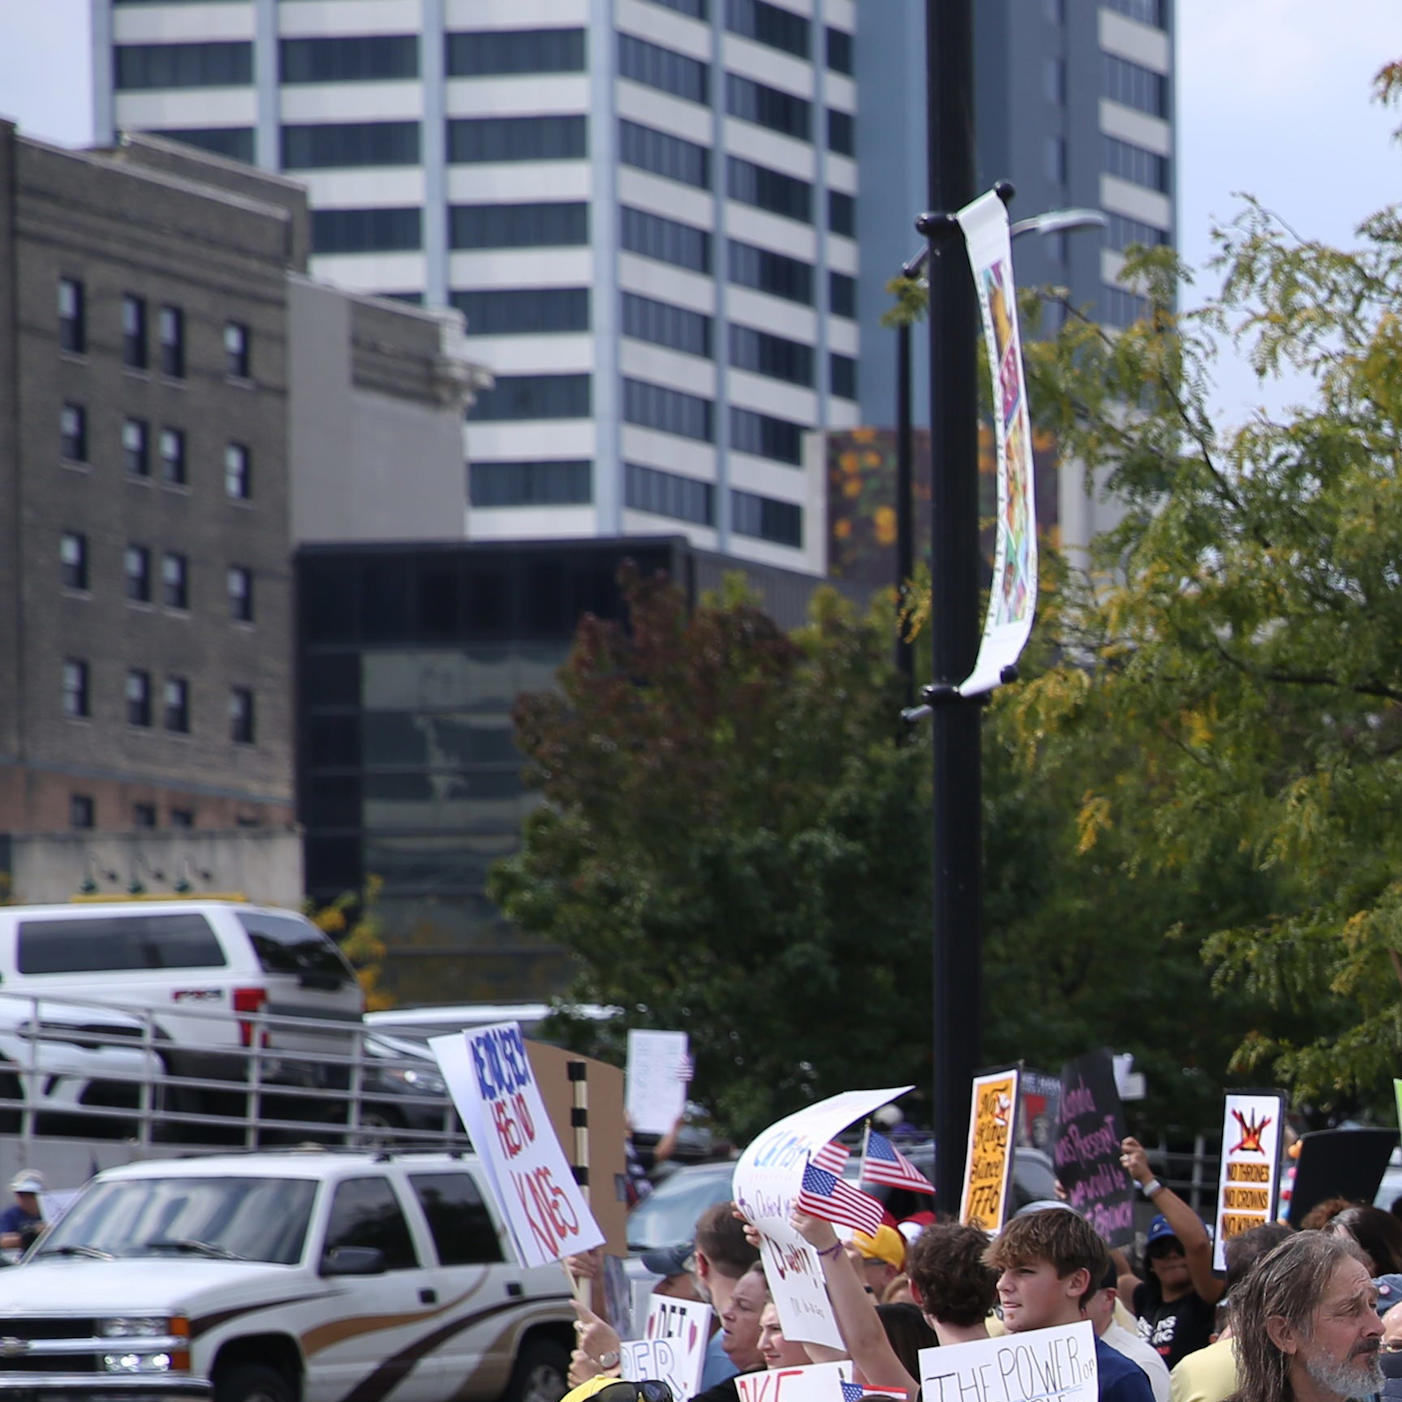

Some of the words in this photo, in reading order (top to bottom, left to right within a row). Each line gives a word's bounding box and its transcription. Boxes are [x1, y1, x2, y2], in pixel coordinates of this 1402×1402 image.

[1226, 1163, 1238, 1182] NO
[1238, 1164, 1270, 1183] THRONES
[1225, 1189, 1237, 1208] NO
[1238, 1190, 1269, 1209] CROWNS
[1223, 1215, 1236, 1240] NO
[996, 1336, 1082, 1402] POWER
